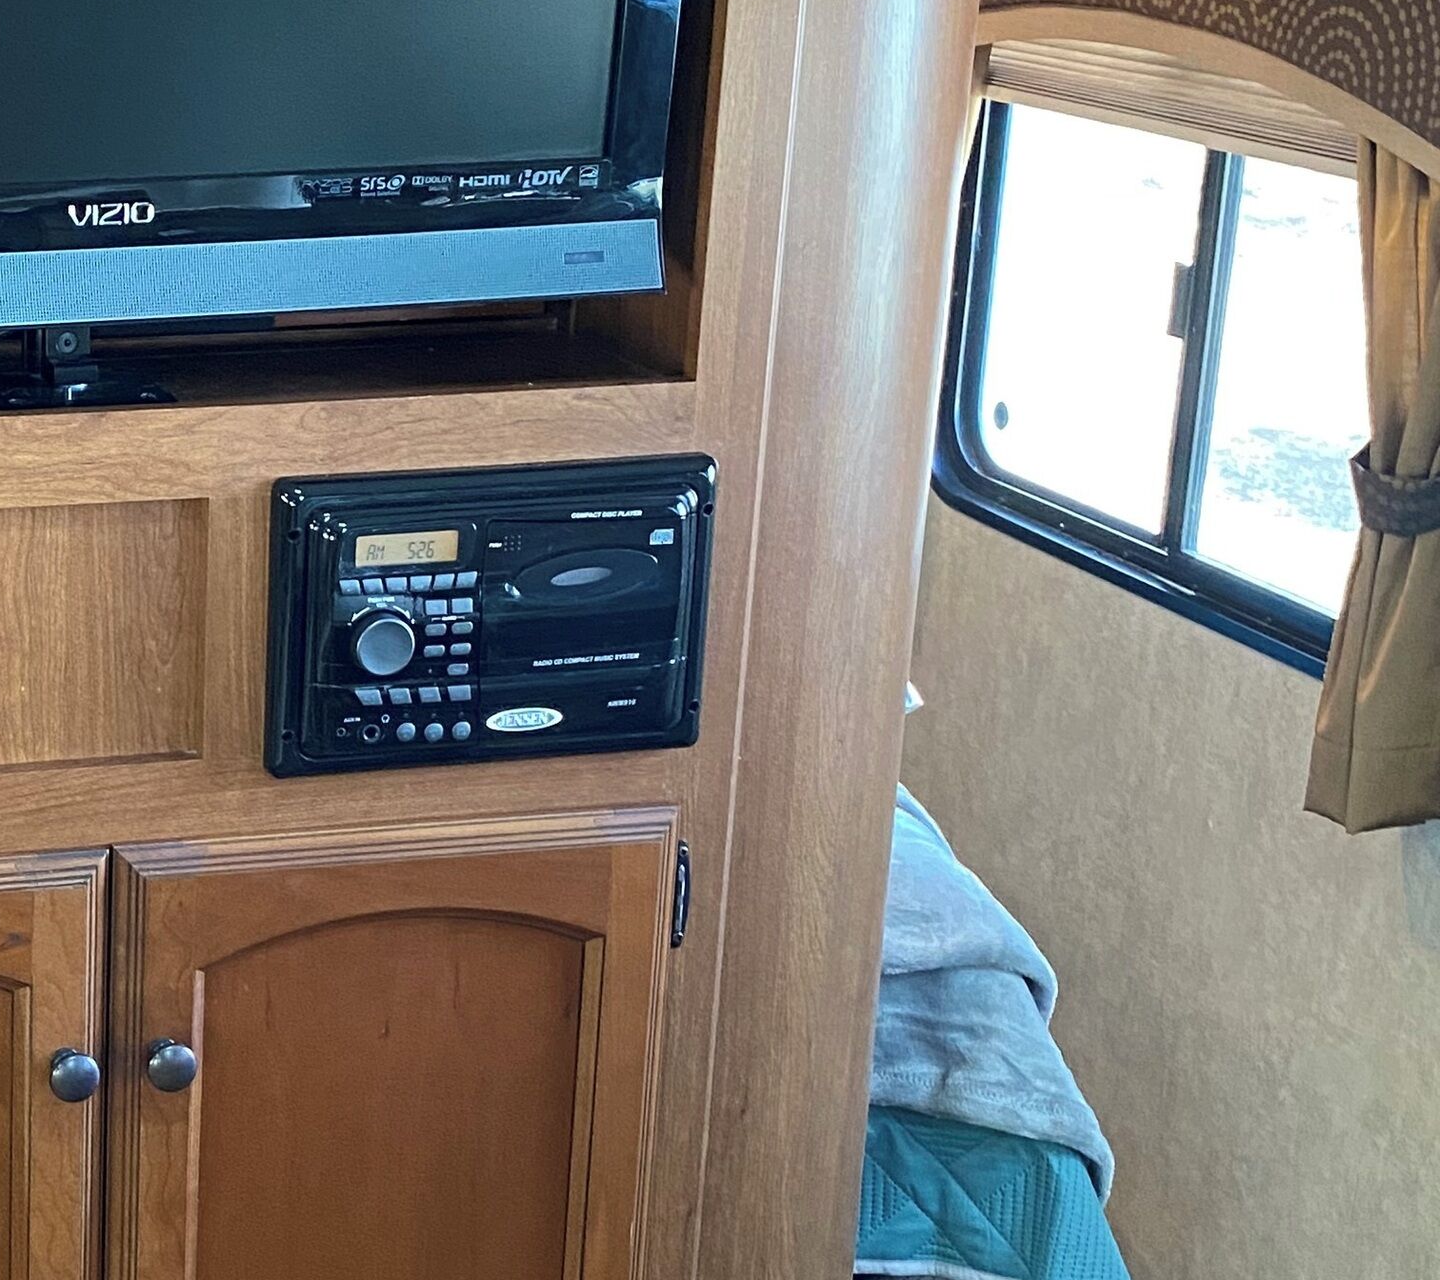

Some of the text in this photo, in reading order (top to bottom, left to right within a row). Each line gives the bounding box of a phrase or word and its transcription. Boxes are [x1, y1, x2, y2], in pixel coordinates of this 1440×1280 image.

[67, 201, 156, 227] VIZIO
[570, 511, 602, 519] COMPACT
[617, 509, 644, 518] PLAYER
[365, 543, 386, 561] AM
[532, 659, 553, 667] RADIO
[563, 656, 594, 664] COMPACT
[614, 652, 640, 660] SYSTEM
[497, 711, 547, 728] JENSEN
